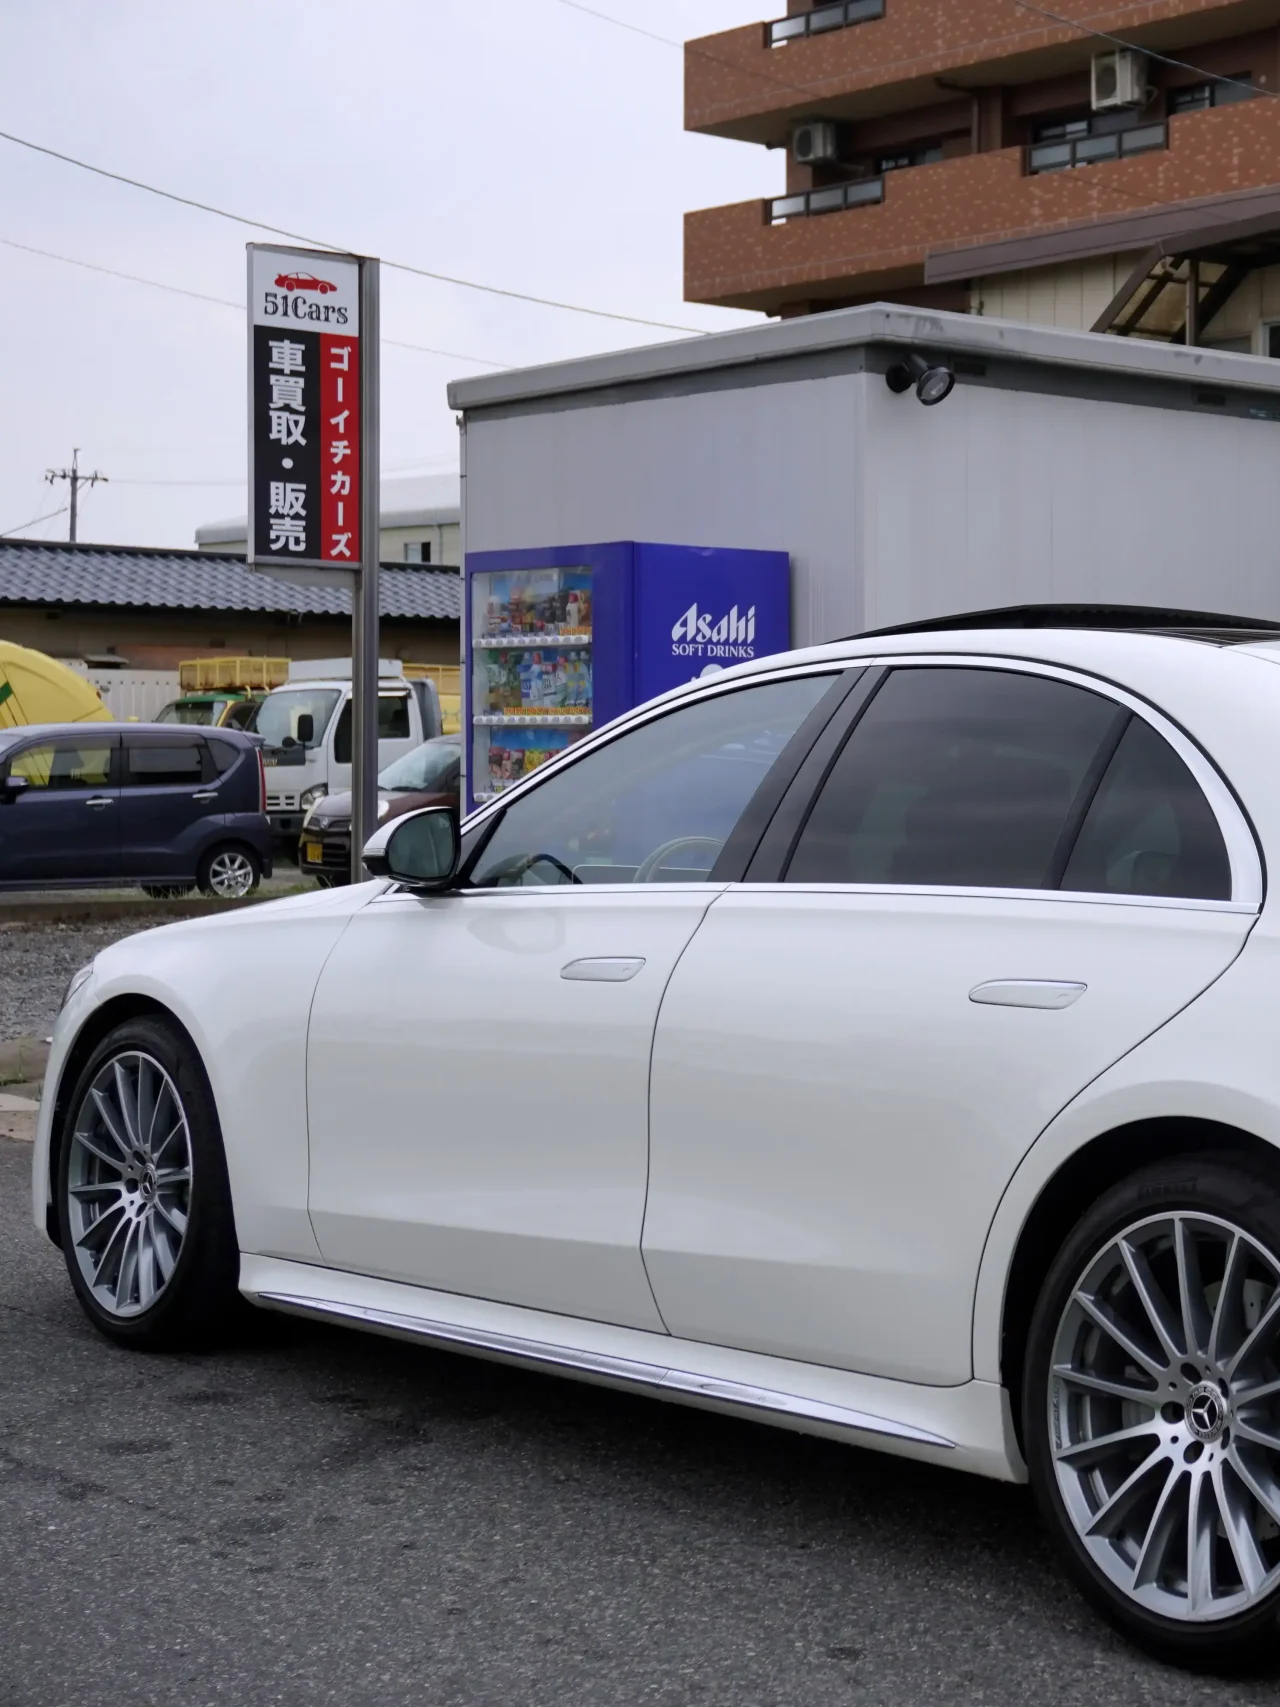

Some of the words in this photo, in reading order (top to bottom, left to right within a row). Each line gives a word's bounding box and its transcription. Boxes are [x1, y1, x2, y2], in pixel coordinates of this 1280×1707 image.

[264, 291, 349, 325] 51Cars
[268, 339, 308, 552] 車買取・販売
[330, 346, 352, 558] ゴーイチカーズ
[671, 602, 755, 644] Asahi
[672, 643, 704, 657] SOFT
[707, 645, 754, 658] DRINKS
